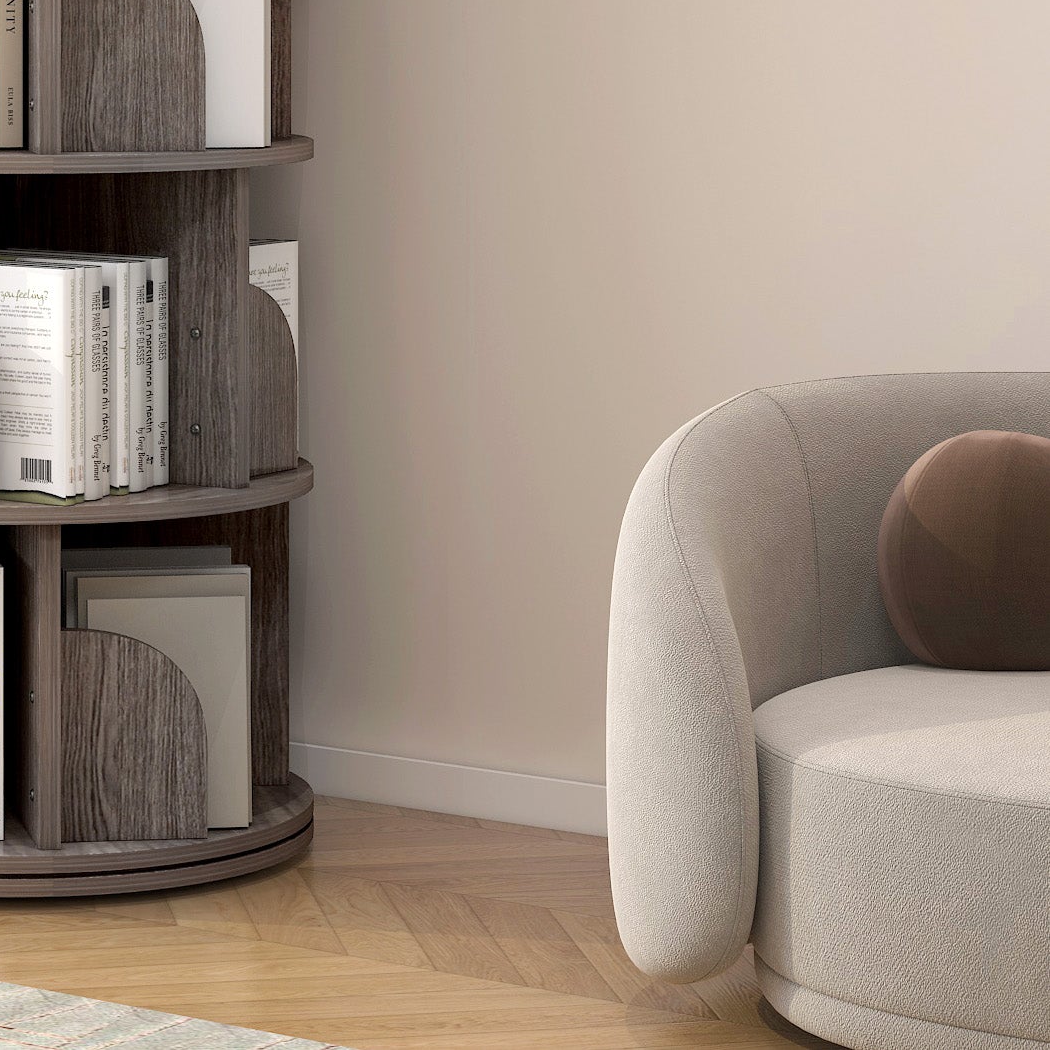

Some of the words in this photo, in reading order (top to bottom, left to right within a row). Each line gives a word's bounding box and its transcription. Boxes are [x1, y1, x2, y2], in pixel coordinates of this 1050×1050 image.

[91, 290, 100, 311] THREE
[136, 285, 145, 305] THREE
[158, 281, 167, 301] THREE
[136, 307, 145, 326] PAIRS
[158, 303, 167, 320] PAIRS
[91, 313, 100, 332] PAIRS
[136, 327, 145, 336] OF
[158, 322, 167, 331] OF
[91, 334, 100, 343] OF
[158, 333, 167, 361] GLASSES
[91, 344, 100, 373] GLASSES
[136, 337, 145, 366] GLASSES
[137, 427, 145, 435] by
[158, 421, 167, 430] by
[137, 436, 145, 451] Greg
[158, 430, 167, 445] Greg
[92, 444, 101, 459] Greg
[160, 446, 168, 467] Bennet
[93, 460, 101, 482] Bennet
